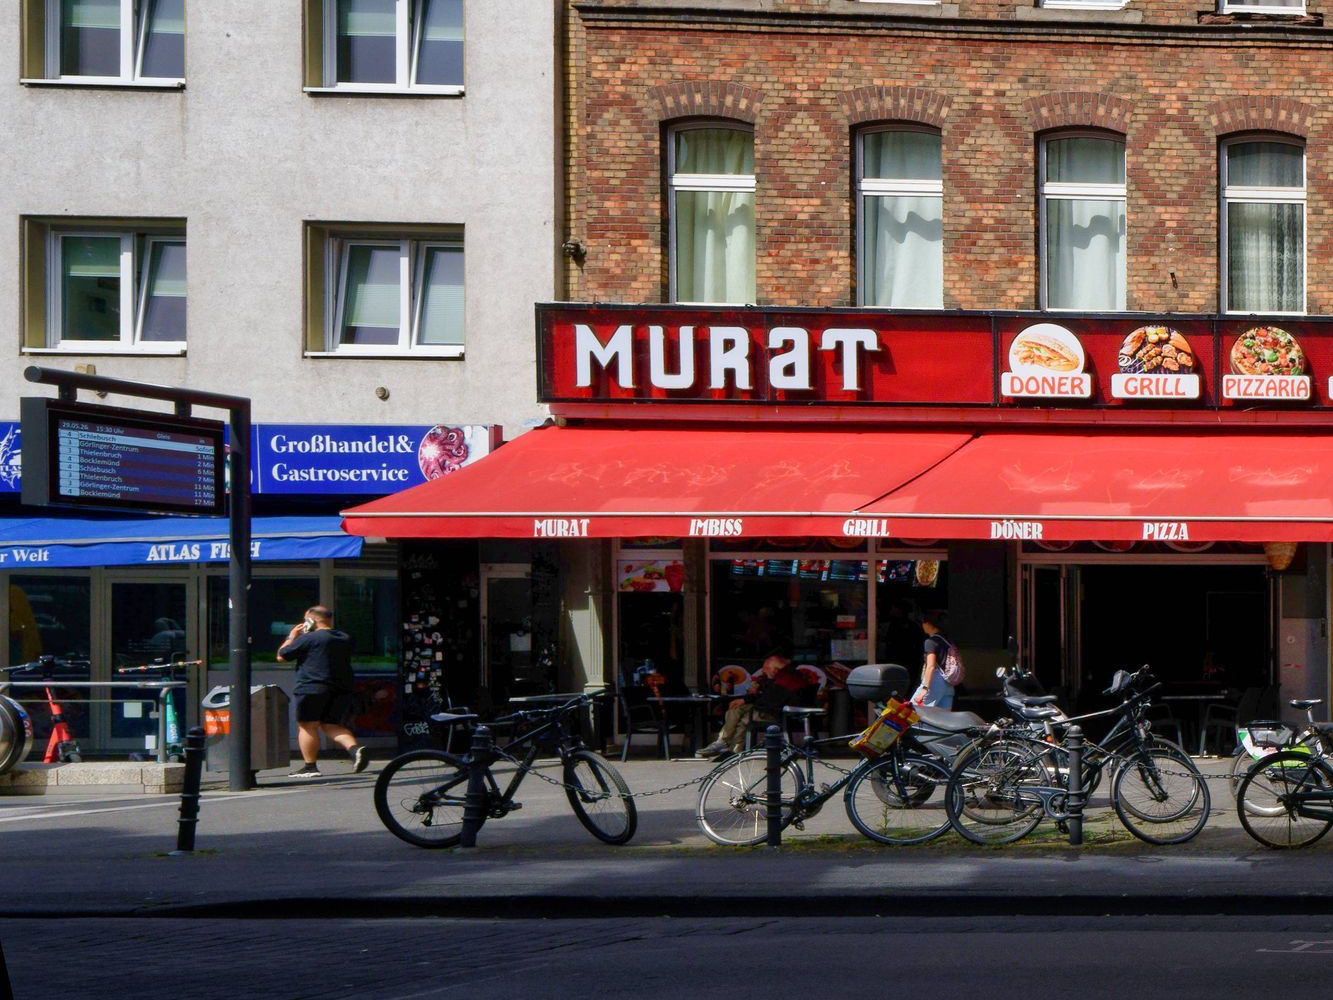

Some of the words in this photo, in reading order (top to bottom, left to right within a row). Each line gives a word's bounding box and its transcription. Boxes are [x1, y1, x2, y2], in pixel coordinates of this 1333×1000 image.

[1010, 376, 1084, 395] DONER
[1124, 377, 1186, 396] GRILL
[1225, 377, 1309, 398] PIZZARIA
[270, 434, 414, 454] Großhandel&
[272, 462, 409, 482] Gastroservice
[534, 519, 590, 537] MURAT
[689, 518, 743, 536] IMBISS
[843, 519, 890, 537] GRILL
[990, 519, 1042, 540] DÖNER
[1142, 522, 1189, 540] PIZZA
[12, 549, 50, 562] Welt
[147, 543, 200, 561] ATLAS
[210, 542, 260, 559] FIH
